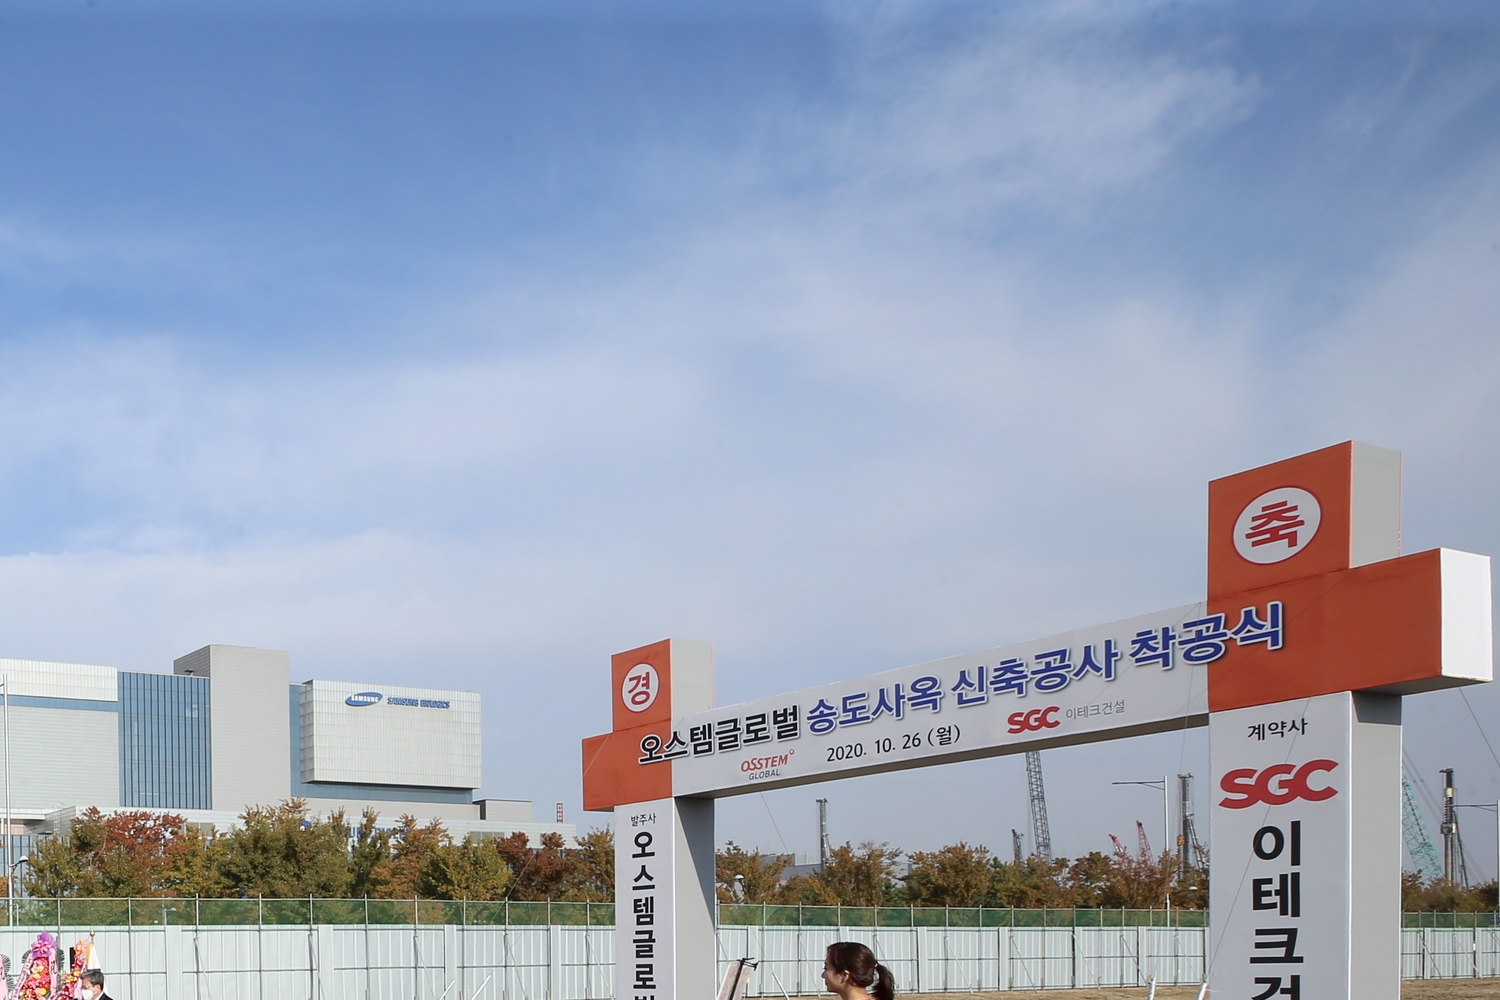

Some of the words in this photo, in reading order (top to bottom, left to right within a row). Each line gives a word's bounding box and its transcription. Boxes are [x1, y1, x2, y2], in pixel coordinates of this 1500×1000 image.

[1245, 501, 1306, 549] 축
[627, 671, 650, 706] 경
[639, 704, 799, 764] 오스템글로벌
[807, 675, 943, 734] 송도사옥
[951, 638, 1120, 708] 신축공사
[1129, 601, 1283, 669] 착공식
[351, 695, 379, 703] SAMSUNG
[387, 697, 418, 707] SAMSUNG
[1065, 700, 1126, 720] 이테크건설
[1007, 706, 1061, 734] SGC
[1247, 718, 1308, 743] 계약사
[826, 743, 867, 763] 2020.
[874, 738, 896, 755] 10.
[902, 734, 922, 750] 26
[927, 724, 961, 746] (월)
[741, 753, 789, 773] OSSTEM
[748, 768, 781, 781] GLOBAL
[1218, 758, 1339, 810] SGC
[630, 812, 657, 827] 발주사
